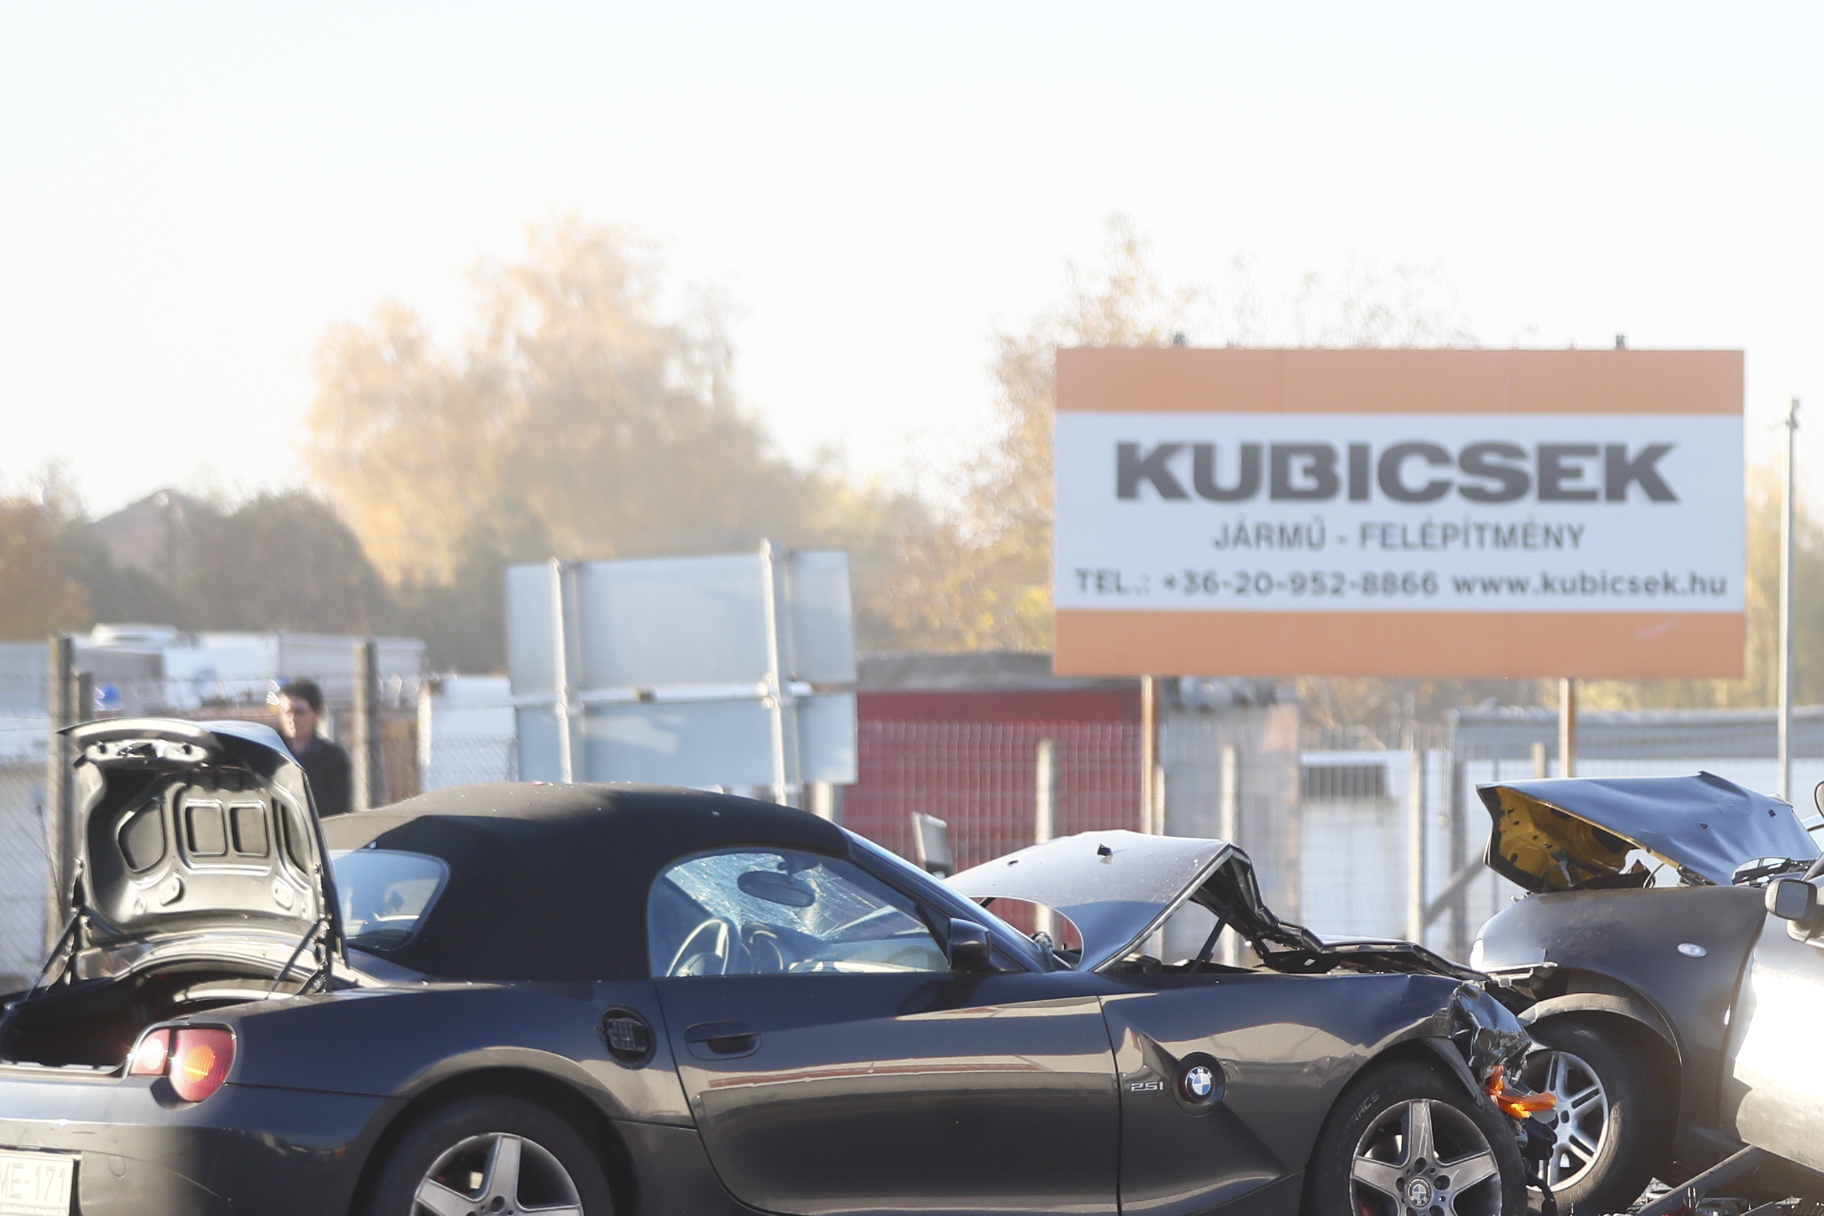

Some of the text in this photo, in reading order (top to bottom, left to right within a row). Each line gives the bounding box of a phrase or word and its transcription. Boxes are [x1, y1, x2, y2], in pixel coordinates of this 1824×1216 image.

[1115, 440, 1681, 503] KUBICSEK
[1212, 514, 1327, 551] JÁRMŰ
[1359, 515, 1586, 550] FELÉPÍTMÉNY
[1162, 569, 1440, 598] +36-20-952-8866
[1452, 570, 1727, 598] www.kubicsek.hu
